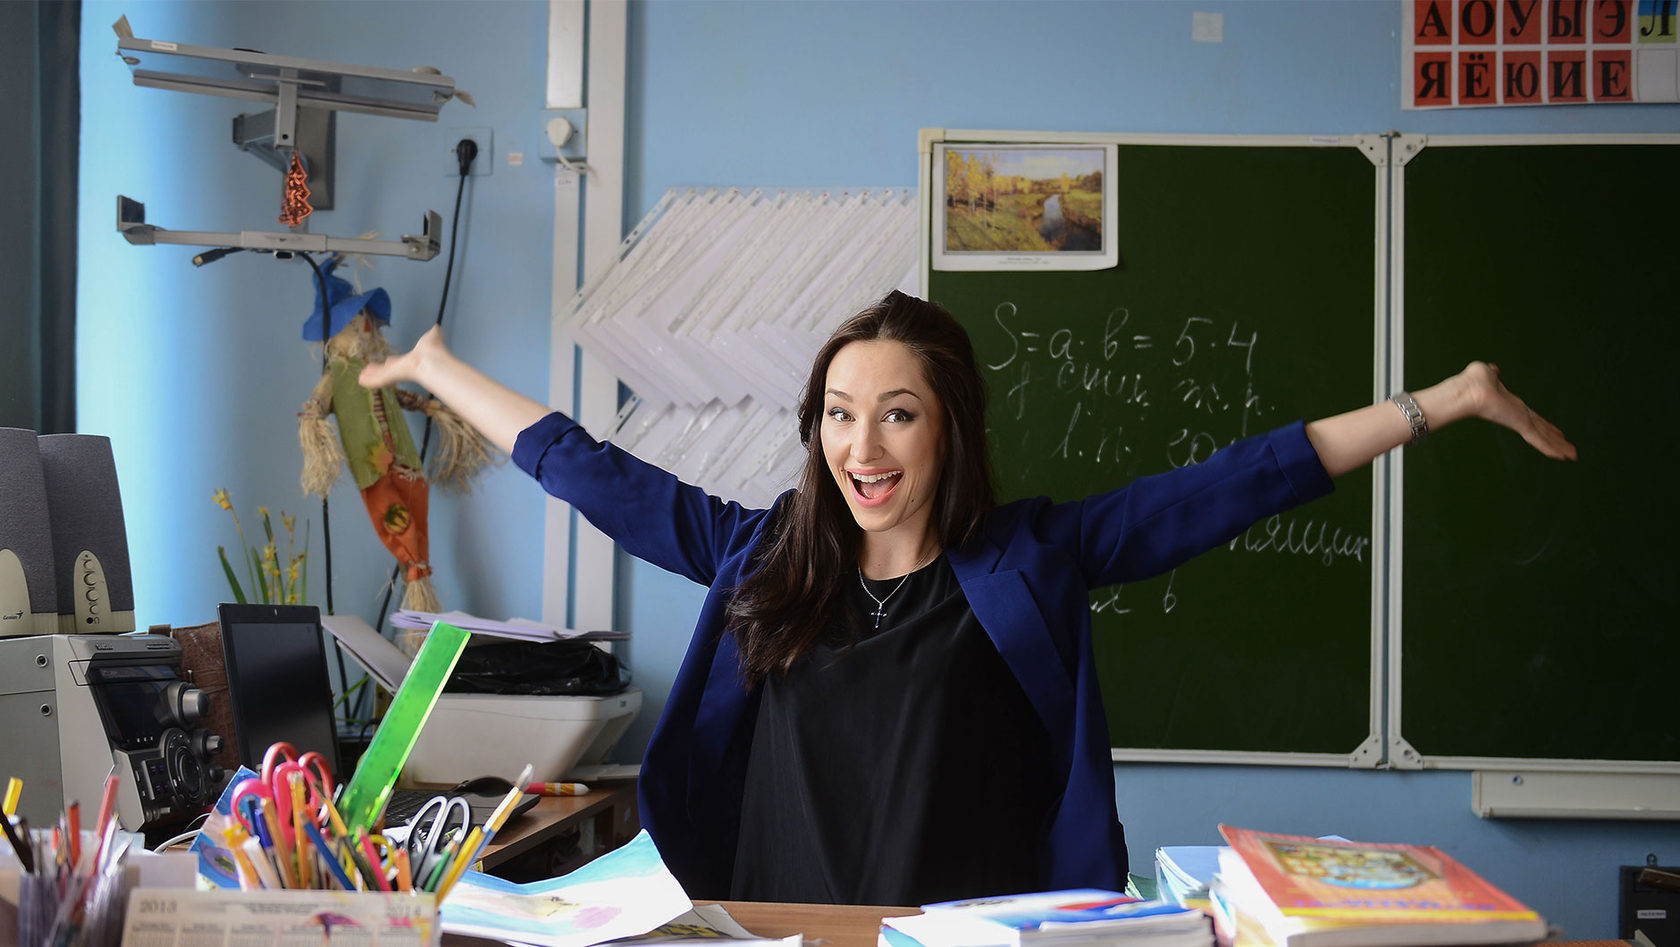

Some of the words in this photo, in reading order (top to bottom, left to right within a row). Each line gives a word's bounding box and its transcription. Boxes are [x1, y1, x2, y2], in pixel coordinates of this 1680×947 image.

[1418, 61, 1449, 98] Я
[1465, 54, 1490, 98] Ё
[1506, 62, 1539, 98] Ю
[1551, 61, 1585, 97] И
